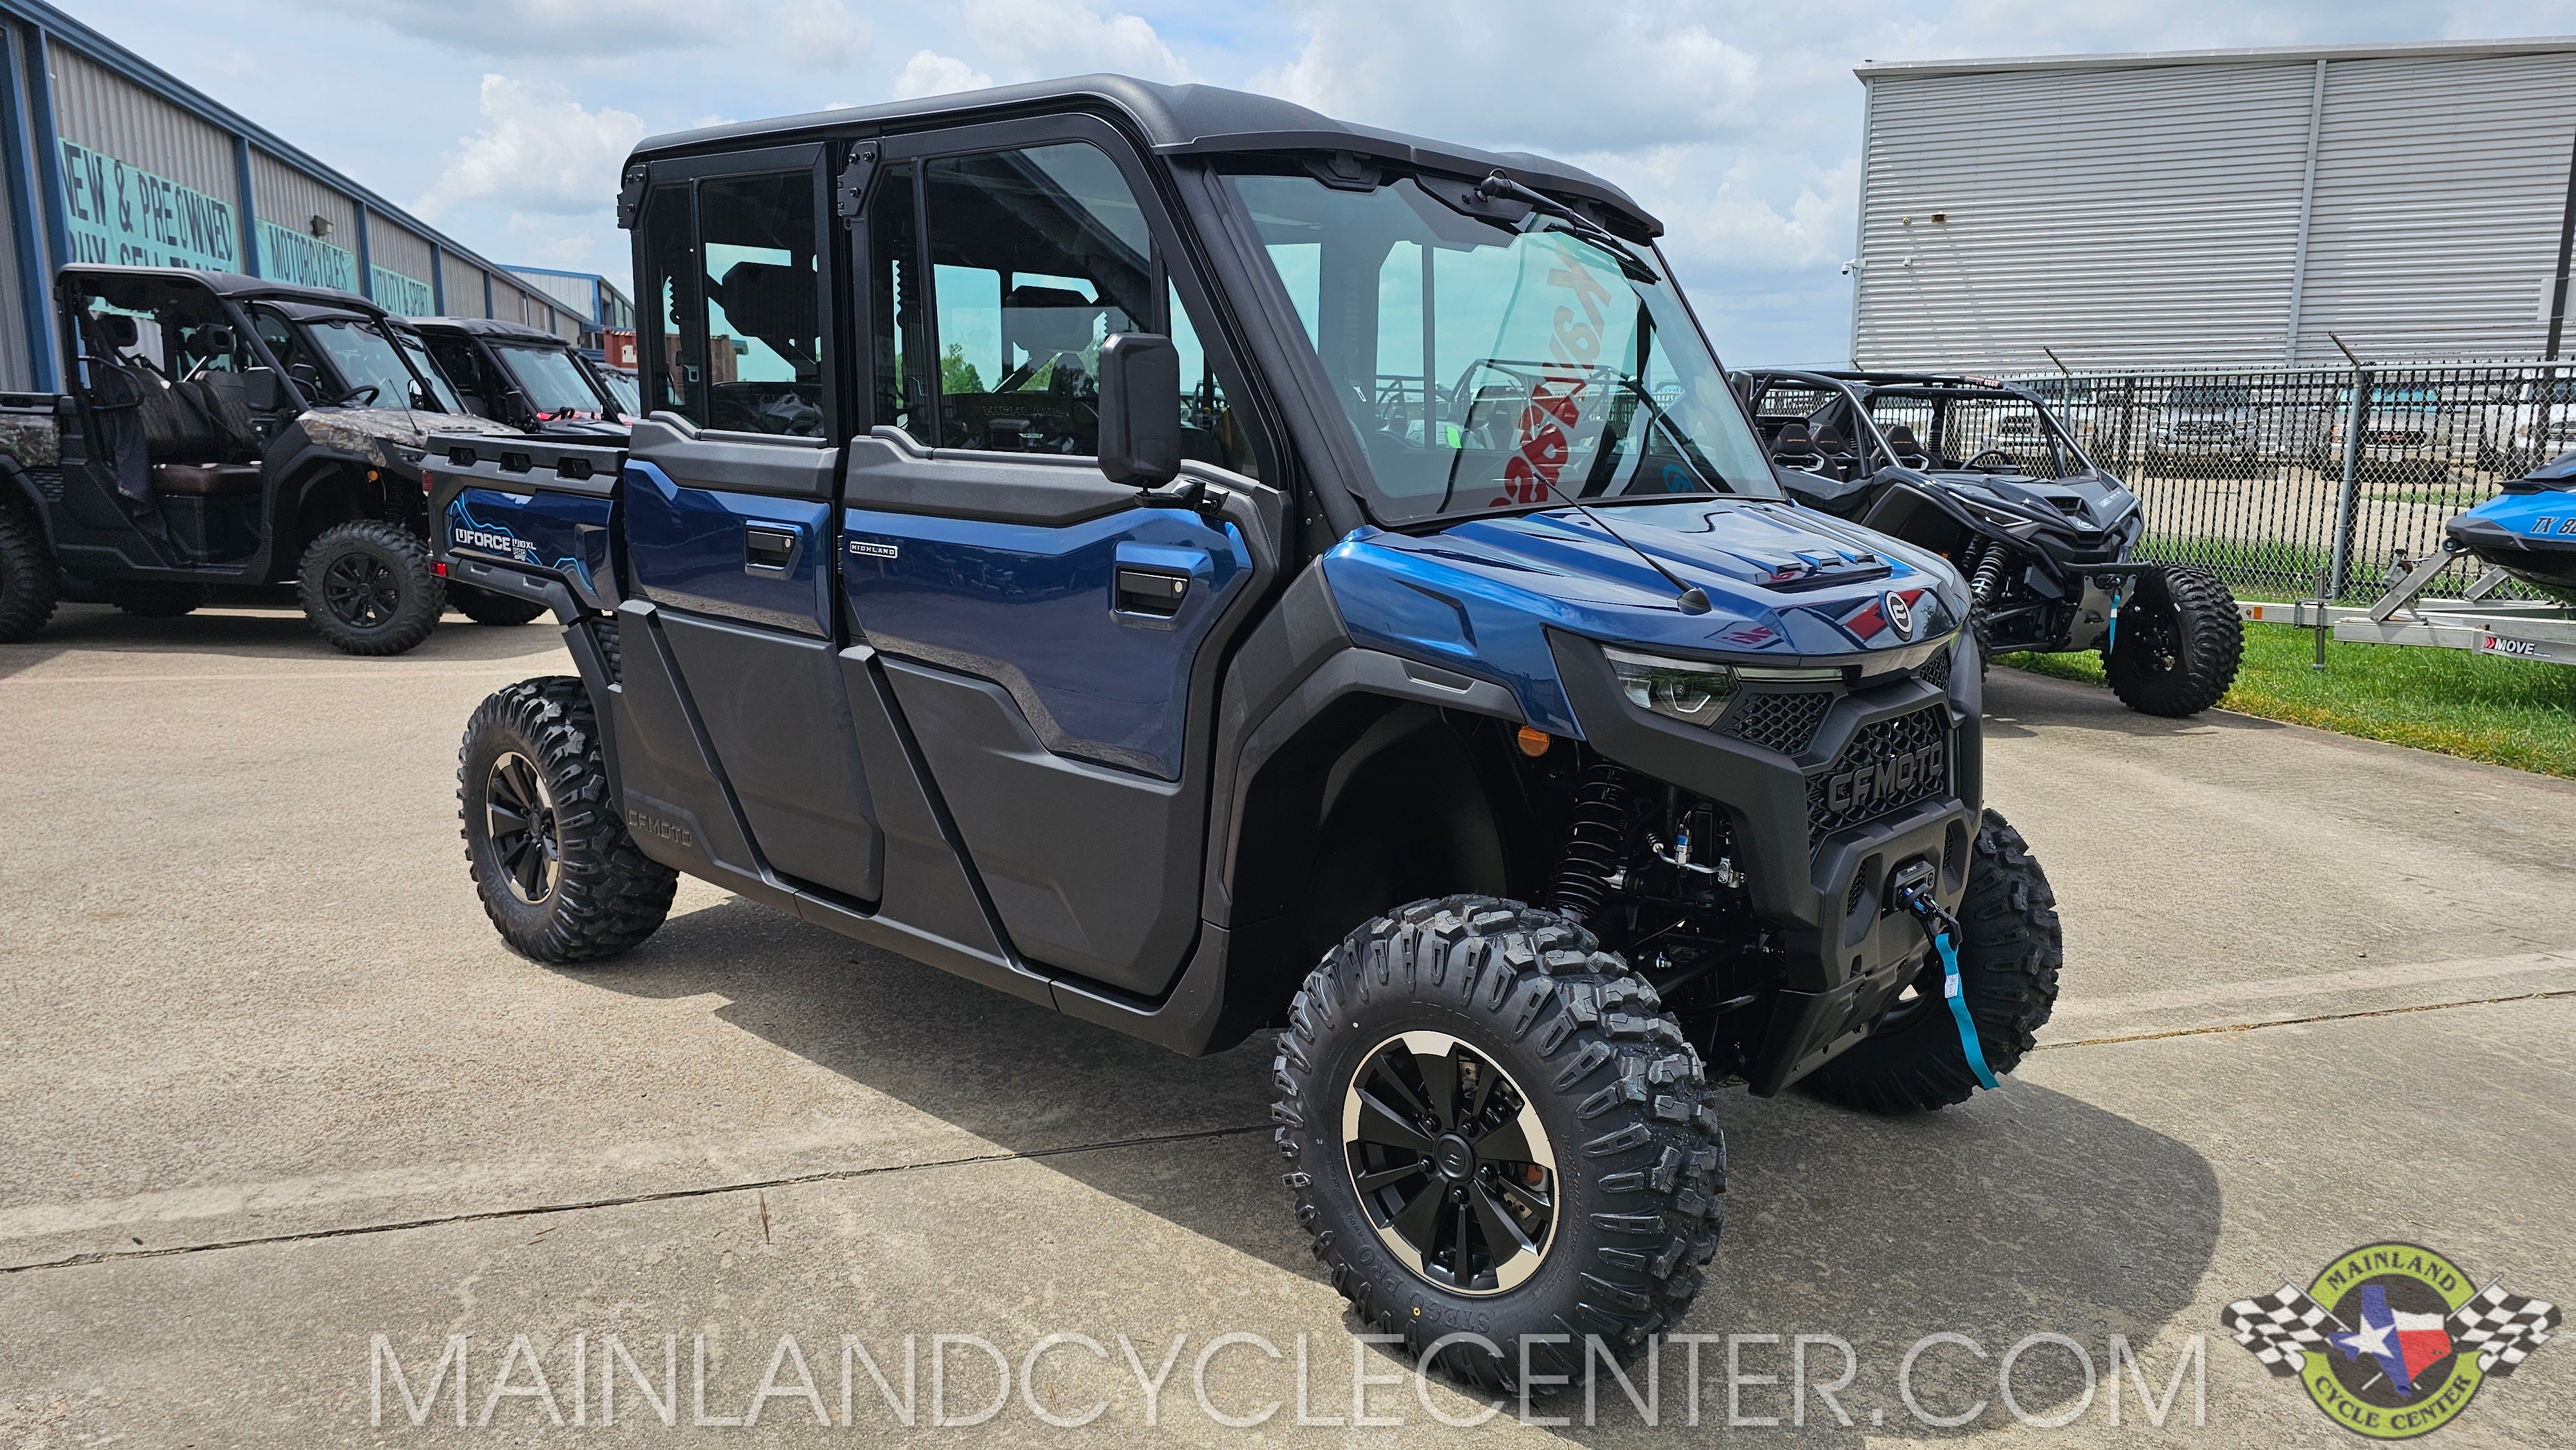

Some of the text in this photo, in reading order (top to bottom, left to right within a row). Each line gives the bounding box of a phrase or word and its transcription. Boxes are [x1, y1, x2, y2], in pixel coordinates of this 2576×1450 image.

[60, 141, 106, 226] NEW
[114, 159, 133, 233] &
[269, 225, 347, 290] MOTORCYCLES
[983, 406, 1063, 418] HIGHLAND
[455, 528, 512, 552] UFORCE
[2531, 517, 2559, 532] TX
[851, 544, 895, 555] HIGHLAND
[2494, 638, 2535, 655] MOVE
[1828, 740, 1944, 812] CFMOTO
[629, 809, 692, 847] CFMOTO
[1357, 1245, 1490, 1334] STEGO PRO
